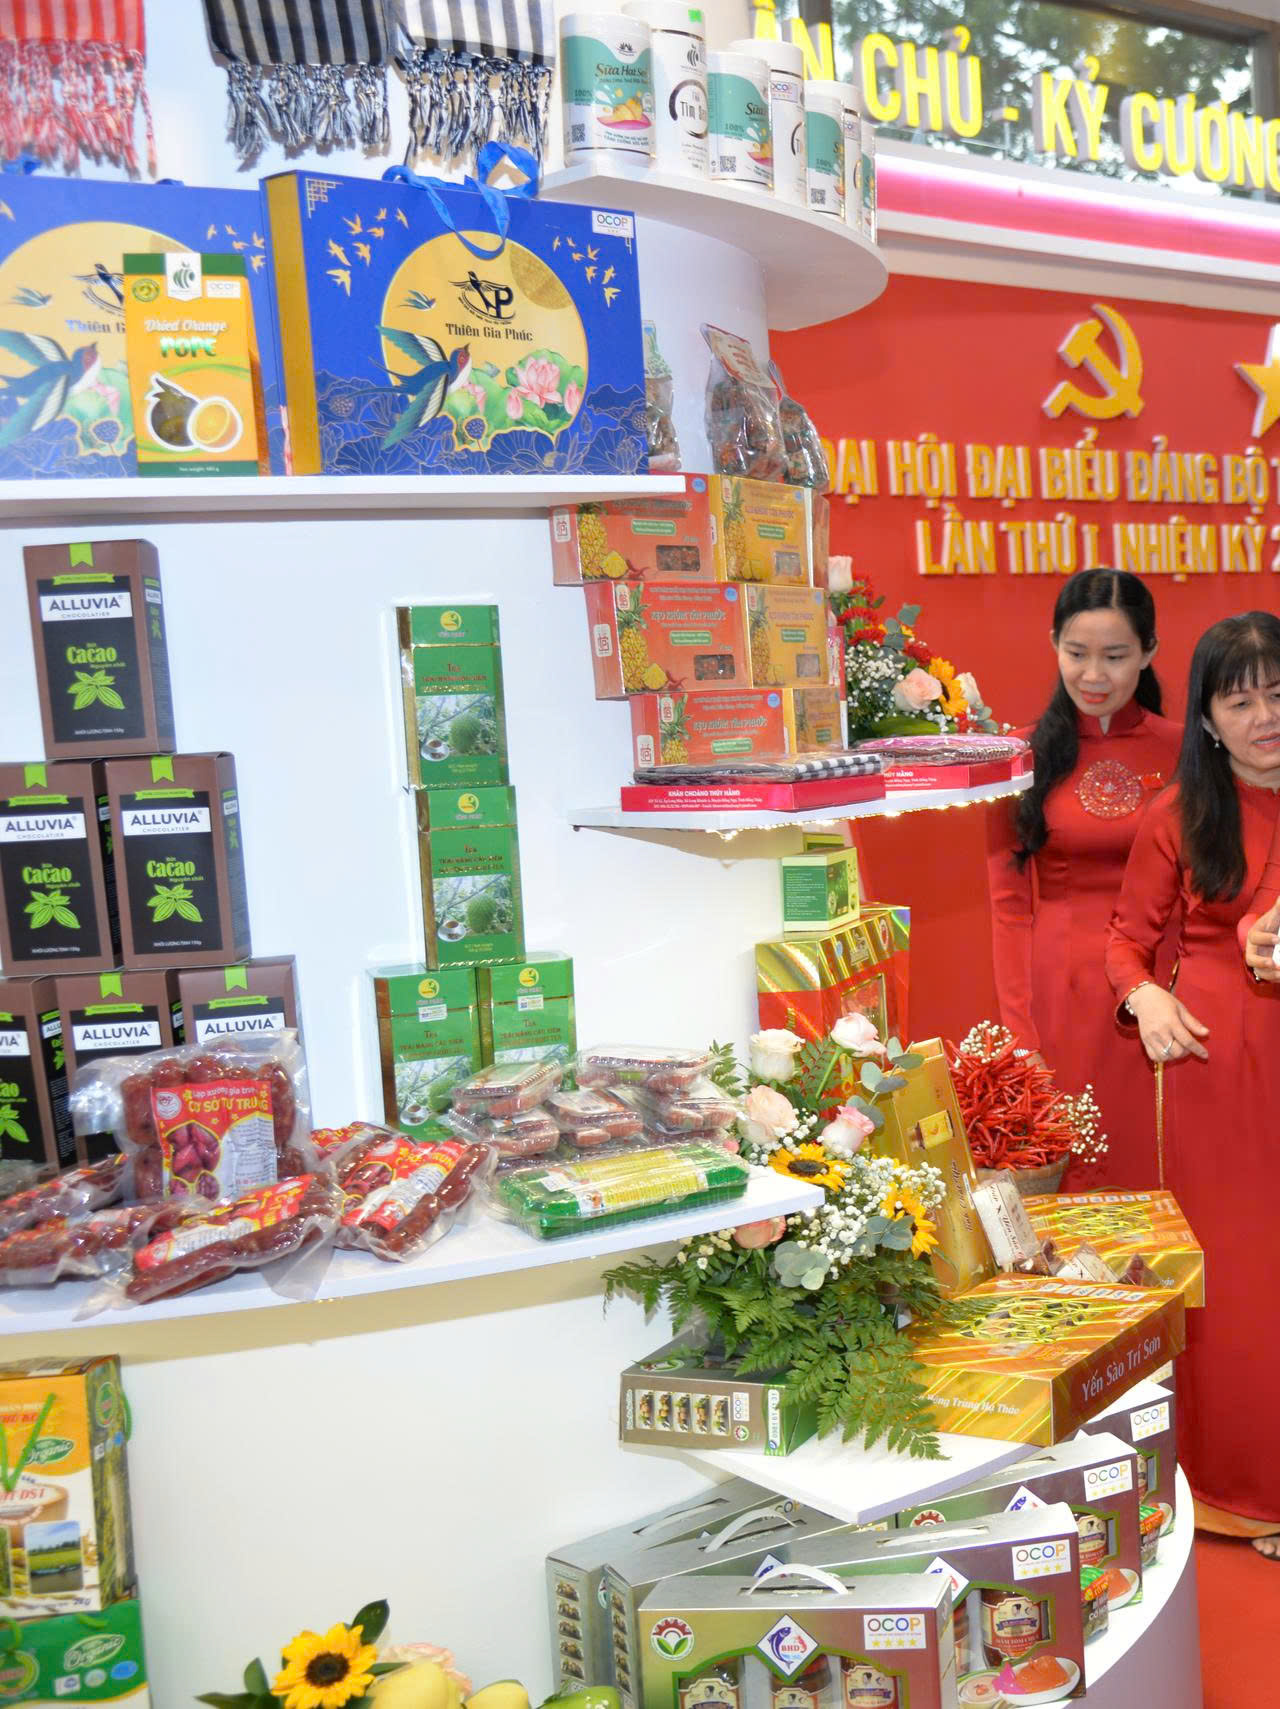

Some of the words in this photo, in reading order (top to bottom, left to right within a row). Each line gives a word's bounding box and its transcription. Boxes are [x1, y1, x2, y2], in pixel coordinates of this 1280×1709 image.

[861, 25, 984, 138] CHỦ
[597, 213, 628, 227] OCOP
[65, 319, 115, 333] Thiên
[446, 322, 480, 339] Thiên
[483, 326, 501, 340] Gia
[505, 327, 533, 342] Phúc
[887, 433, 958, 508] HỘI
[966, 444, 1032, 508] ĐẠI
[1040, 427, 1120, 501] BIỂU
[1126, 435, 1219, 503] ĐẢNG
[1222, 446, 1269, 514] BỘ
[916, 502, 997, 575] LẦN
[999, 512, 1077, 574] THỨ
[1112, 515, 1218, 582] NHIỆM
[1221, 516, 1266, 573] KỲ
[49, 597, 121, 611] ALLUVIA
[66, 646, 117, 664] Cacao
[5, 817, 75, 832] ALLUVIA
[131, 811, 200, 826] ALLUVIA
[22, 866, 72, 884] Cacao
[146, 860, 196, 878] Cacao
[82, 1026, 150, 1041] ALLUVIA
[205, 1019, 275, 1034] ALLUVIA
[0, 1034, 20, 1047] VIA
[1082, 1370, 1104, 1402] Yến
[1106, 1356, 1124, 1385] Sào
[1127, 1345, 1141, 1372] Trí
[1143, 1336, 1161, 1359] Sơn
[1133, 1404, 1167, 1427] OCOP
[1087, 1464, 1129, 1485] OCOP
[1016, 1543, 1066, 1563] OCOP
[867, 1616, 921, 1632] OCOP
[781, 1645, 800, 1653] BHD
